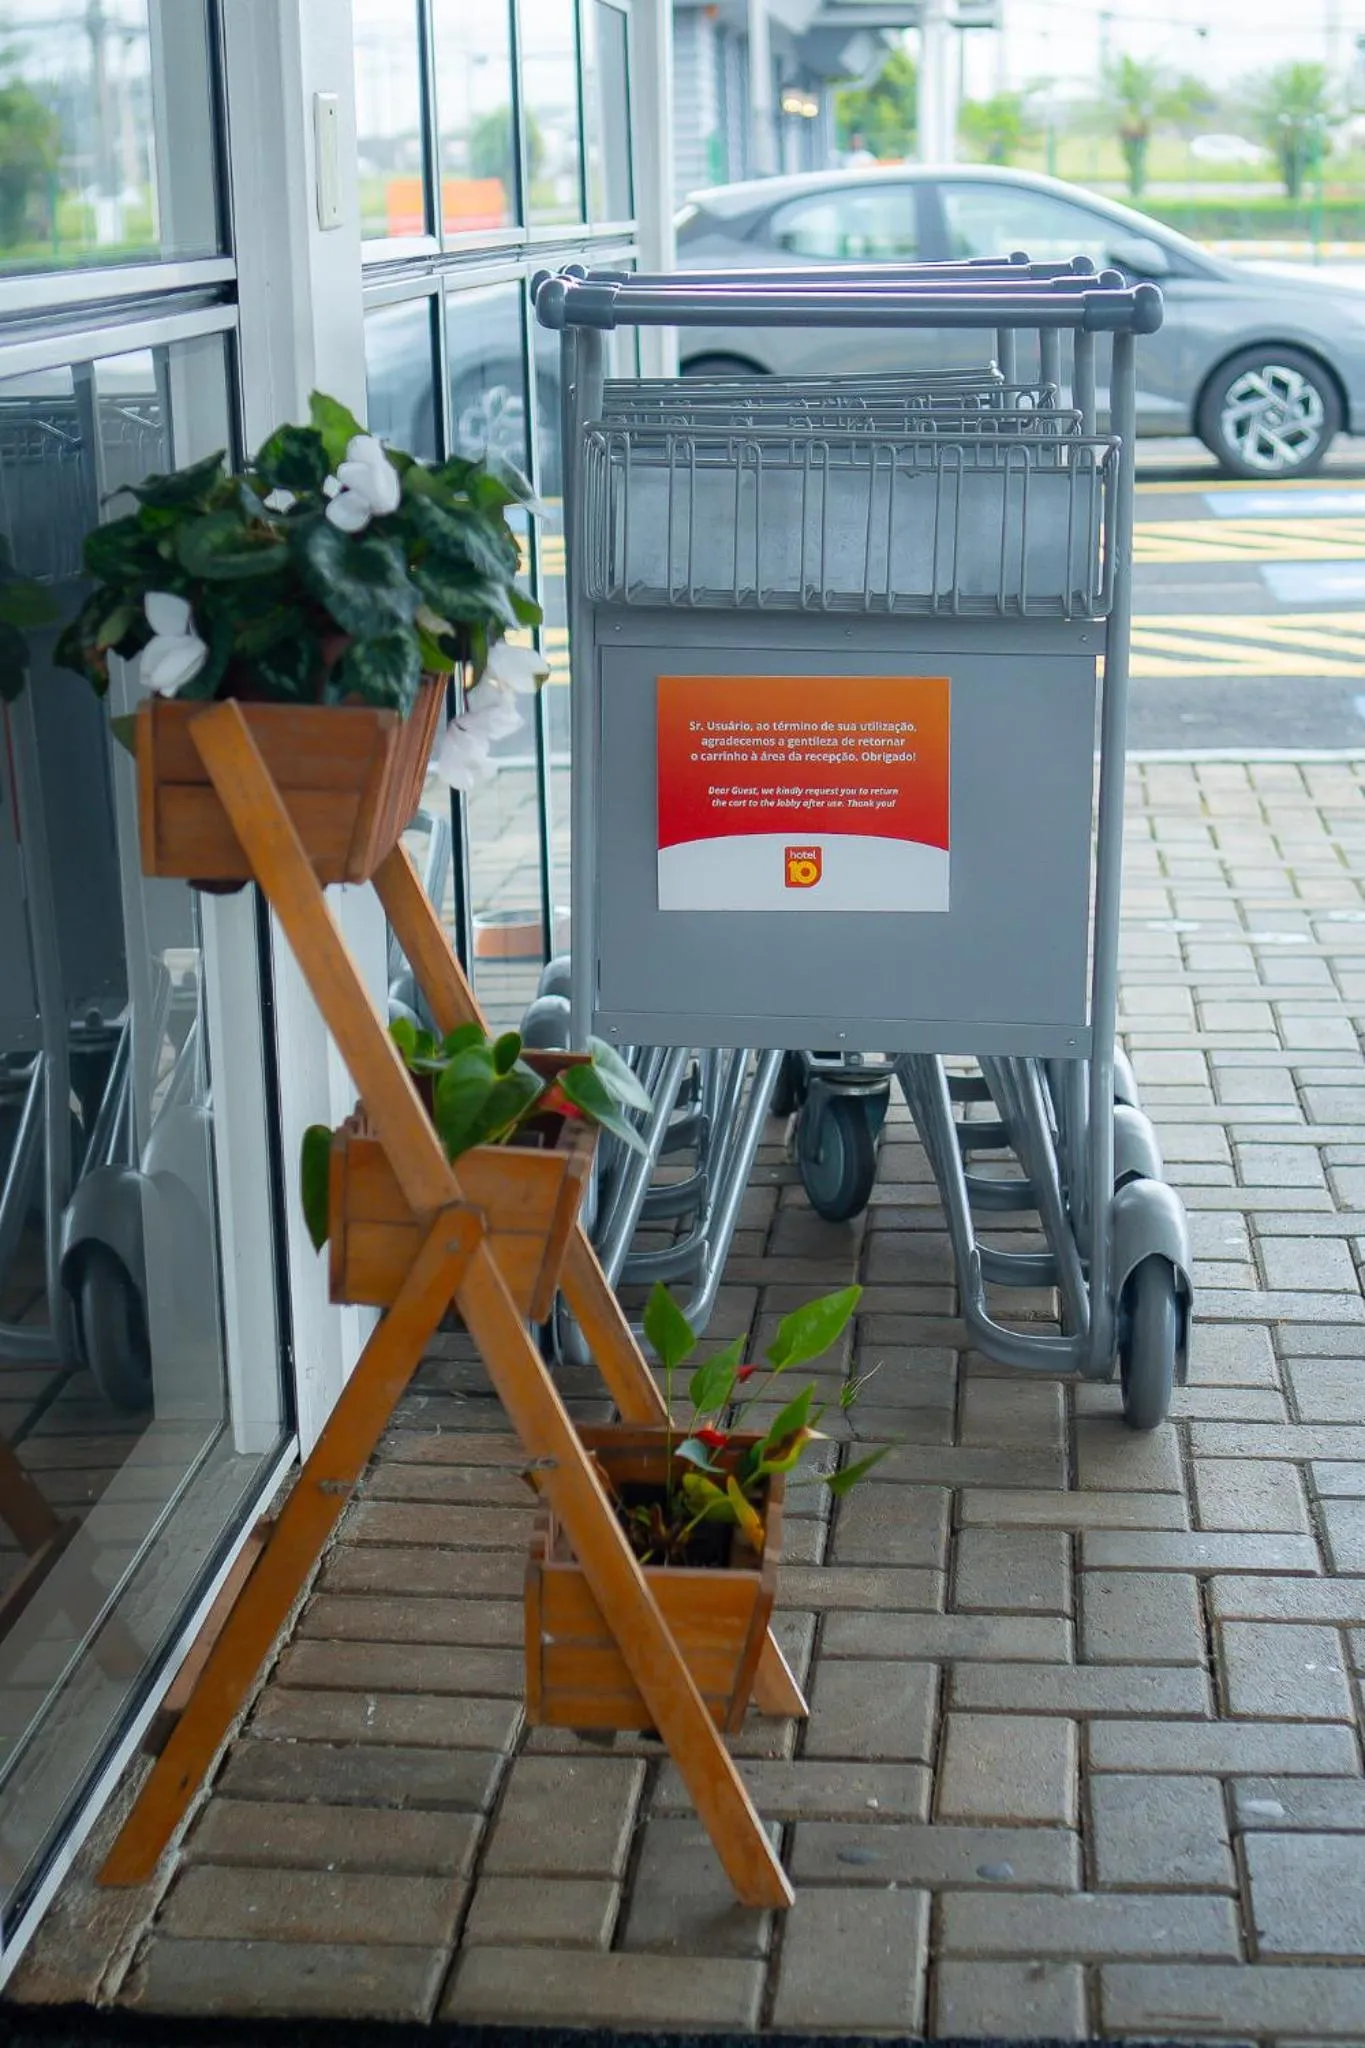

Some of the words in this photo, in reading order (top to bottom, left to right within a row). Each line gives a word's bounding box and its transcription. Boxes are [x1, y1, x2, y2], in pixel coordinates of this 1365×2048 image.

[689, 720, 703, 731] Sr.
[707, 721, 754, 732] Usuário,
[756, 723, 770, 731] ao
[773, 721, 818, 732] término
[820, 721, 835, 732] de
[837, 723, 857, 731] sua
[860, 721, 917, 734] utilização,
[701, 736, 776, 748] agradecemos
[778, 738, 785, 746] a
[787, 736, 838, 749] gentileza
[841, 737, 855, 746] de
[858, 738, 906, 746] retornar
[690, 753, 698, 761] o
[700, 751, 749, 761] carrinho
[750, 751, 758, 761] à
[760, 751, 785, 761] área
[788, 752, 802, 761] da
[805, 752, 859, 764] recepção.
[861, 752, 917, 764] Obrigado!
[708, 786, 730, 795] Dear
[731, 786, 760, 796] Guest,
[775, 786, 804, 797] kindly
[804, 787, 840, 797] request
[840, 788, 857, 797] you
[859, 787, 869, 795] to
[870, 787, 899, 795] return
[711, 799, 727, 807] the
[728, 799, 748, 807] cart
[749, 799, 758, 807] to
[760, 799, 775, 808] the
[776, 799, 801, 809] lobby
[802, 799, 826, 809] after
[848, 799, 875, 808] Thank
[875, 799, 897, 810] you!
[789, 848, 817, 860] hotel
[787, 859, 817, 885] 10
